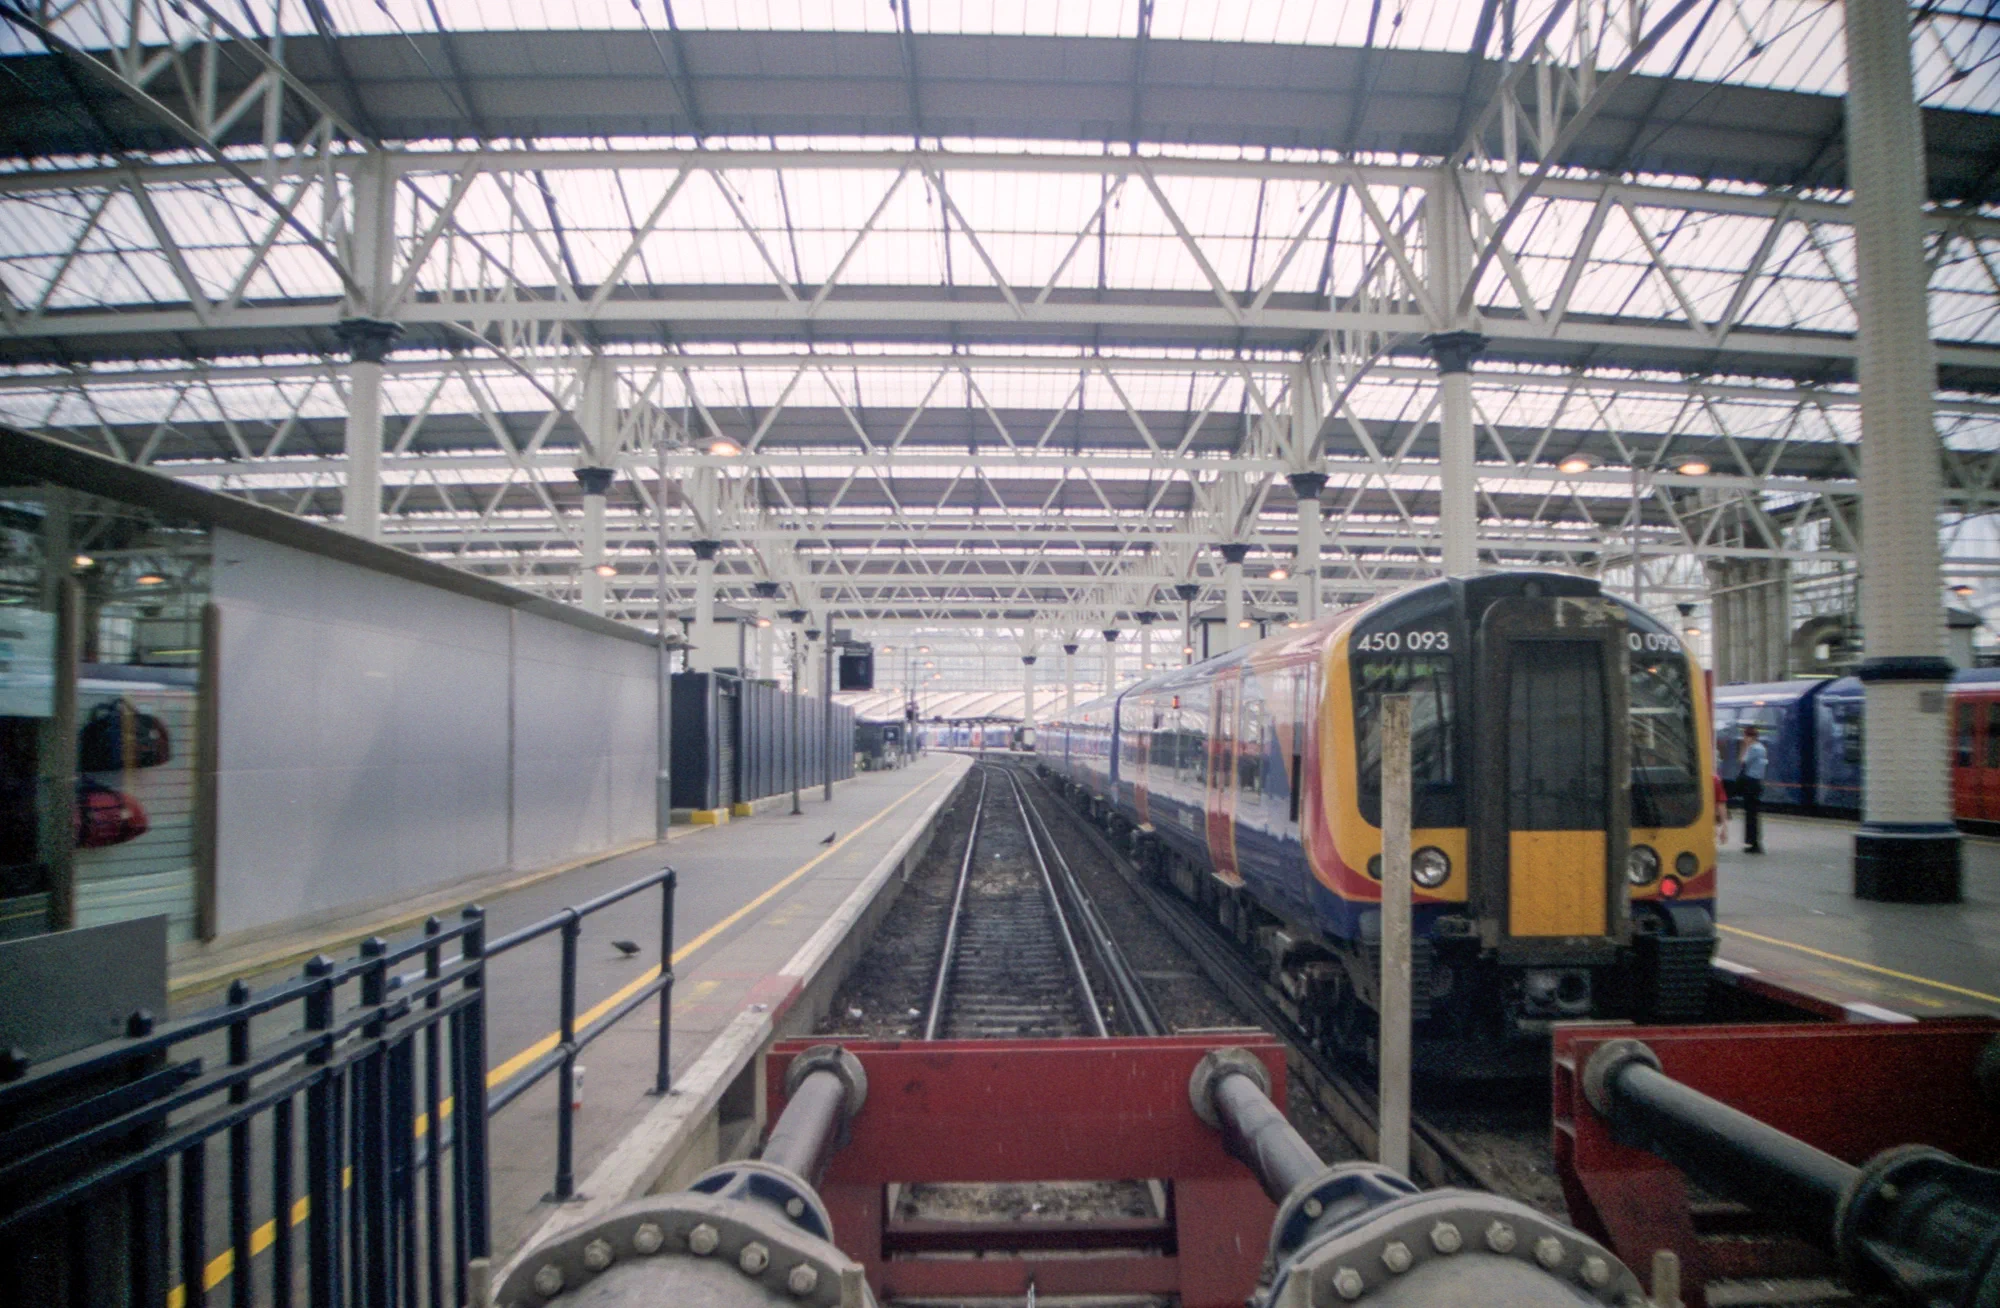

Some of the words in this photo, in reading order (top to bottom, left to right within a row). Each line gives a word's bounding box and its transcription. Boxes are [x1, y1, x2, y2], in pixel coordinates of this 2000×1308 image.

[1357, 631, 1400, 652] 450
[1406, 631, 1450, 651] 093
[1646, 632, 1681, 653] 093
